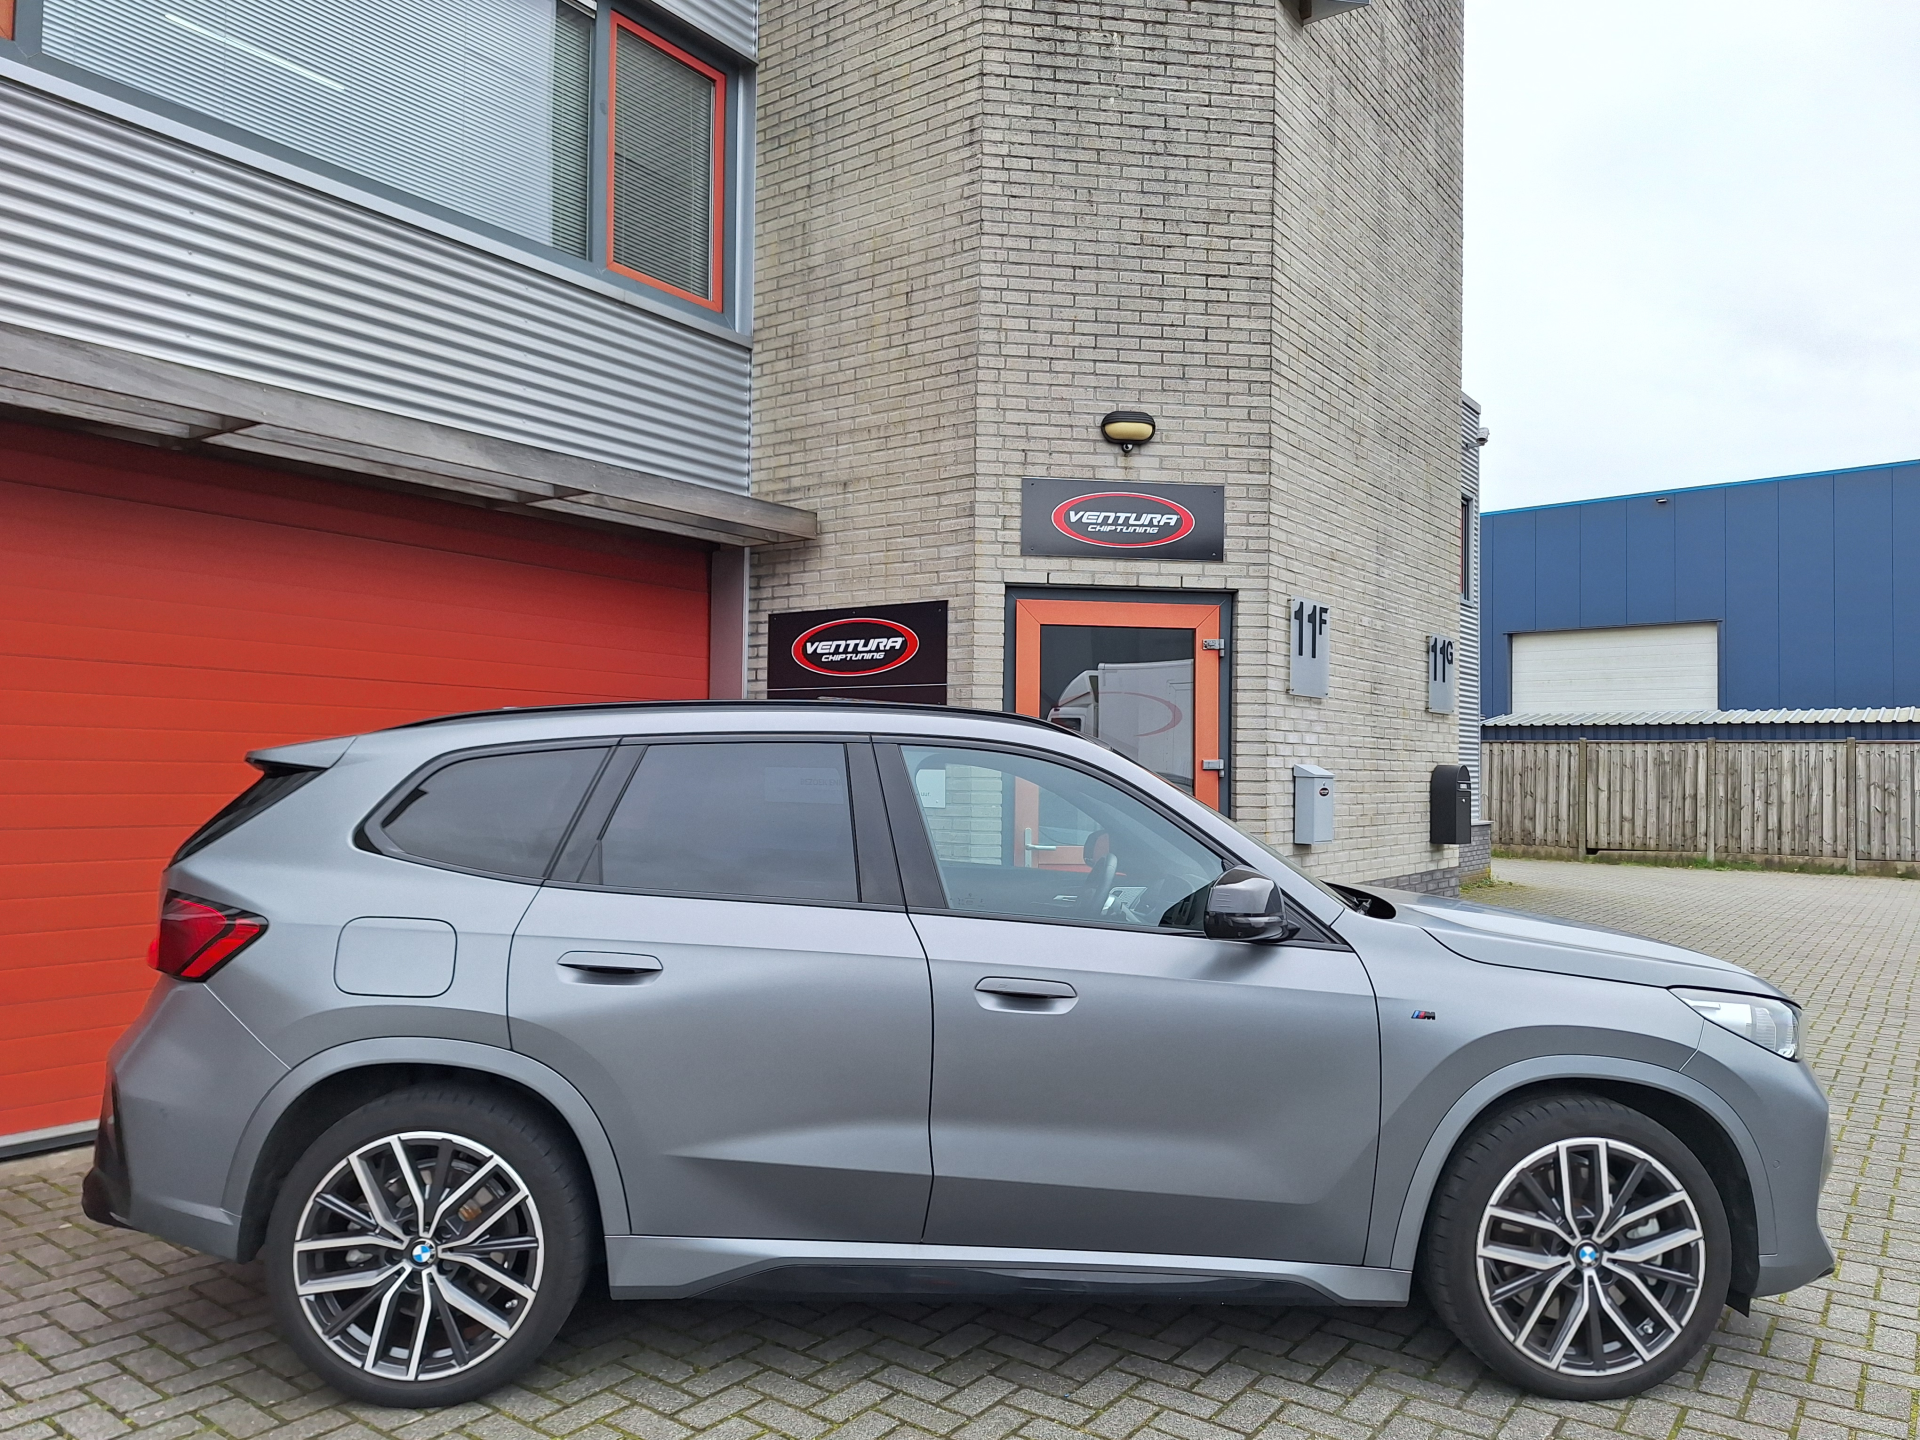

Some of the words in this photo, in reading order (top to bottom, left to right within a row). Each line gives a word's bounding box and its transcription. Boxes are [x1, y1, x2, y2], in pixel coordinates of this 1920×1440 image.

[1069, 511, 1179, 526] VENTURA
[1087, 525, 1159, 534] CHIPTUNING
[1294, 601, 1329, 659] 11F
[806, 637, 904, 655] VENTURA
[821, 652, 885, 662] CHIPTUNING
[1431, 637, 1454, 683] 11G
